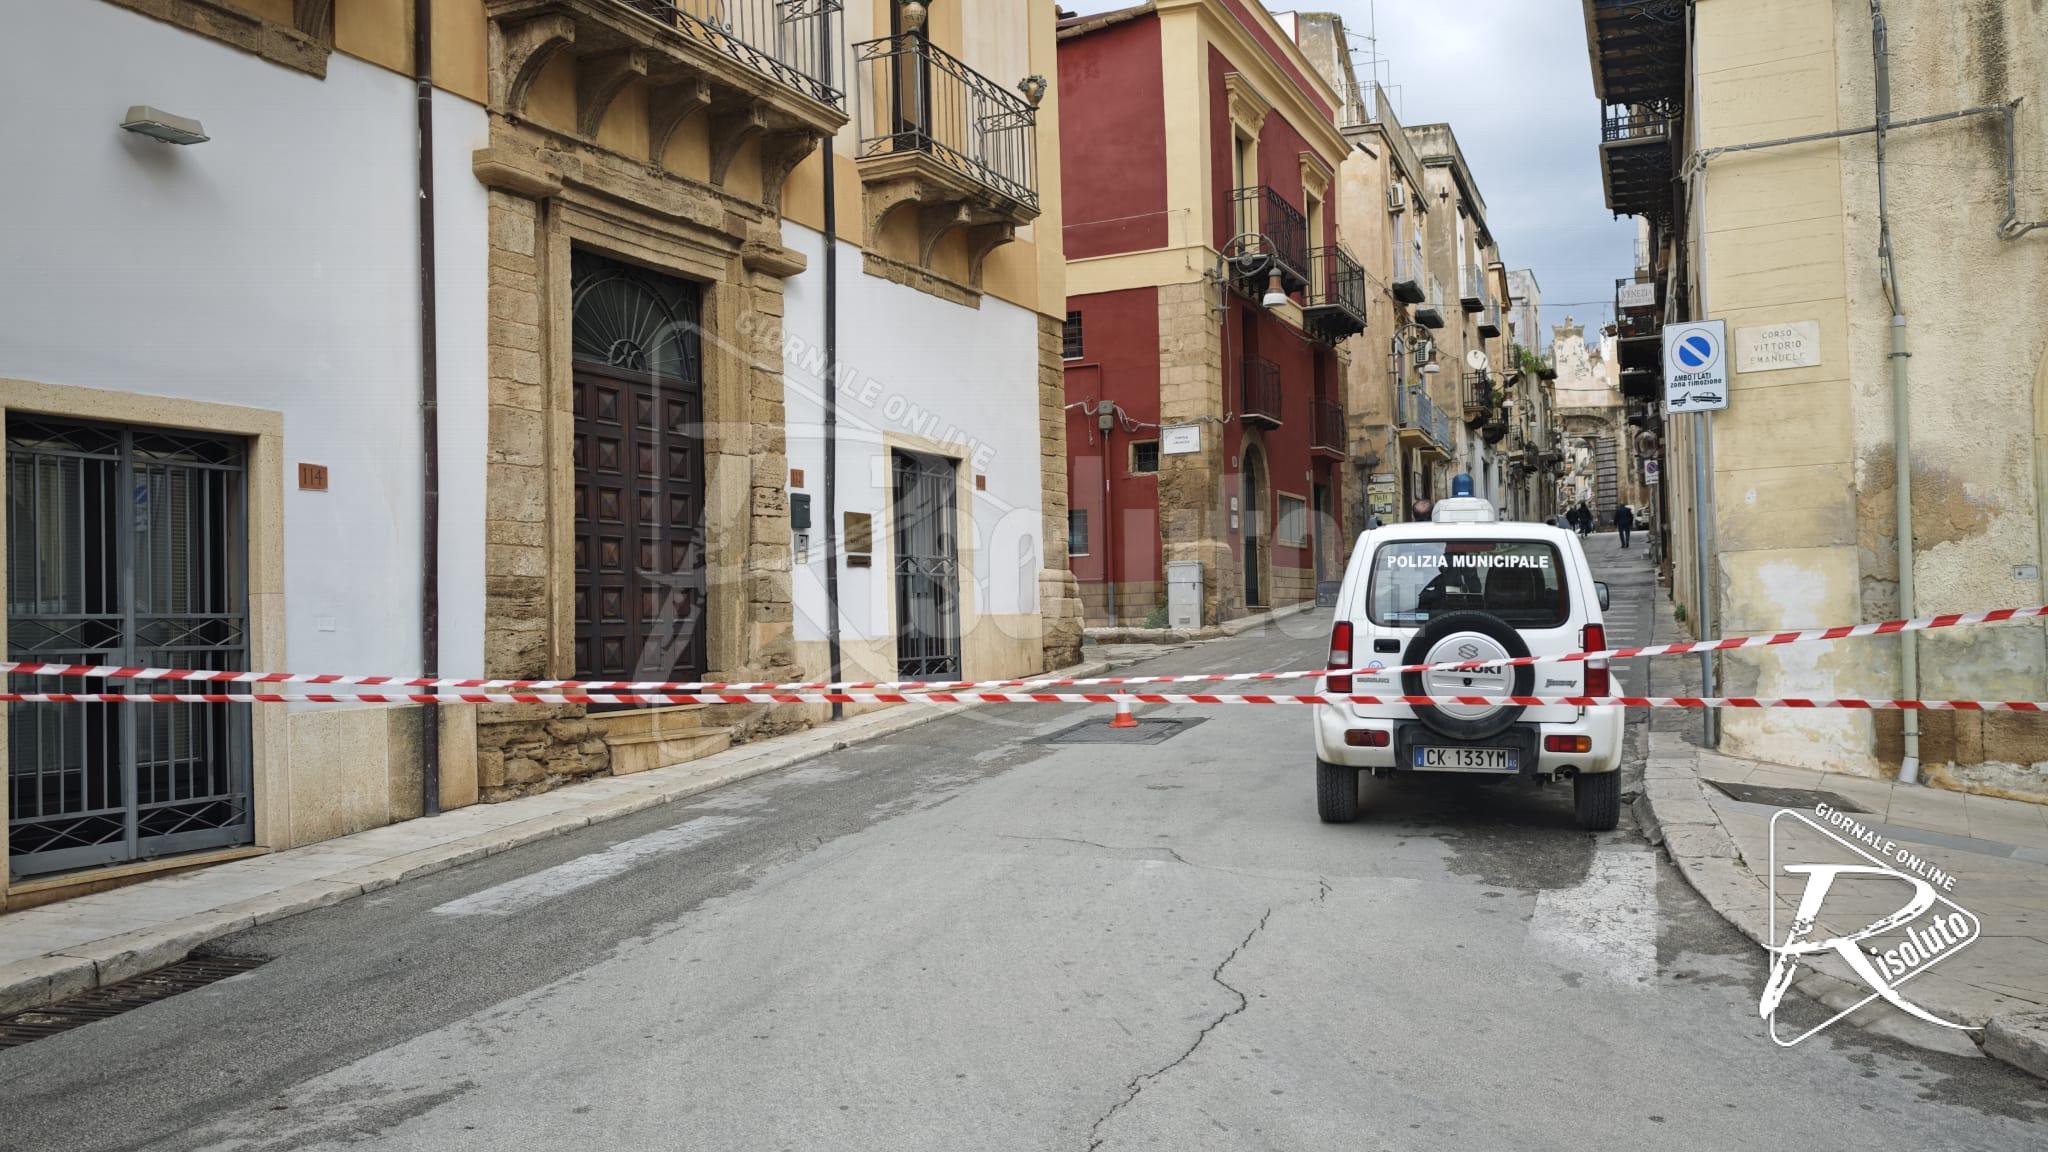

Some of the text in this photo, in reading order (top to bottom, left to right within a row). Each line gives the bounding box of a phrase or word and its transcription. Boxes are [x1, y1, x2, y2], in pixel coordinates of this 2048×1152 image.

[1762, 329, 1792, 339] CORSO
[1753, 340, 1802, 351] VITTORIO
[1674, 374, 1692, 382] AMBO
[1697, 372, 1712, 380] LATI
[1688, 378, 1722, 387] rimozione
[303, 467, 325, 486] 114
[1387, 555, 1549, 568] POLIZIA MUNICIPALE
[1427, 749, 1446, 766] CK
[1455, 750, 1506, 768] 133YM
